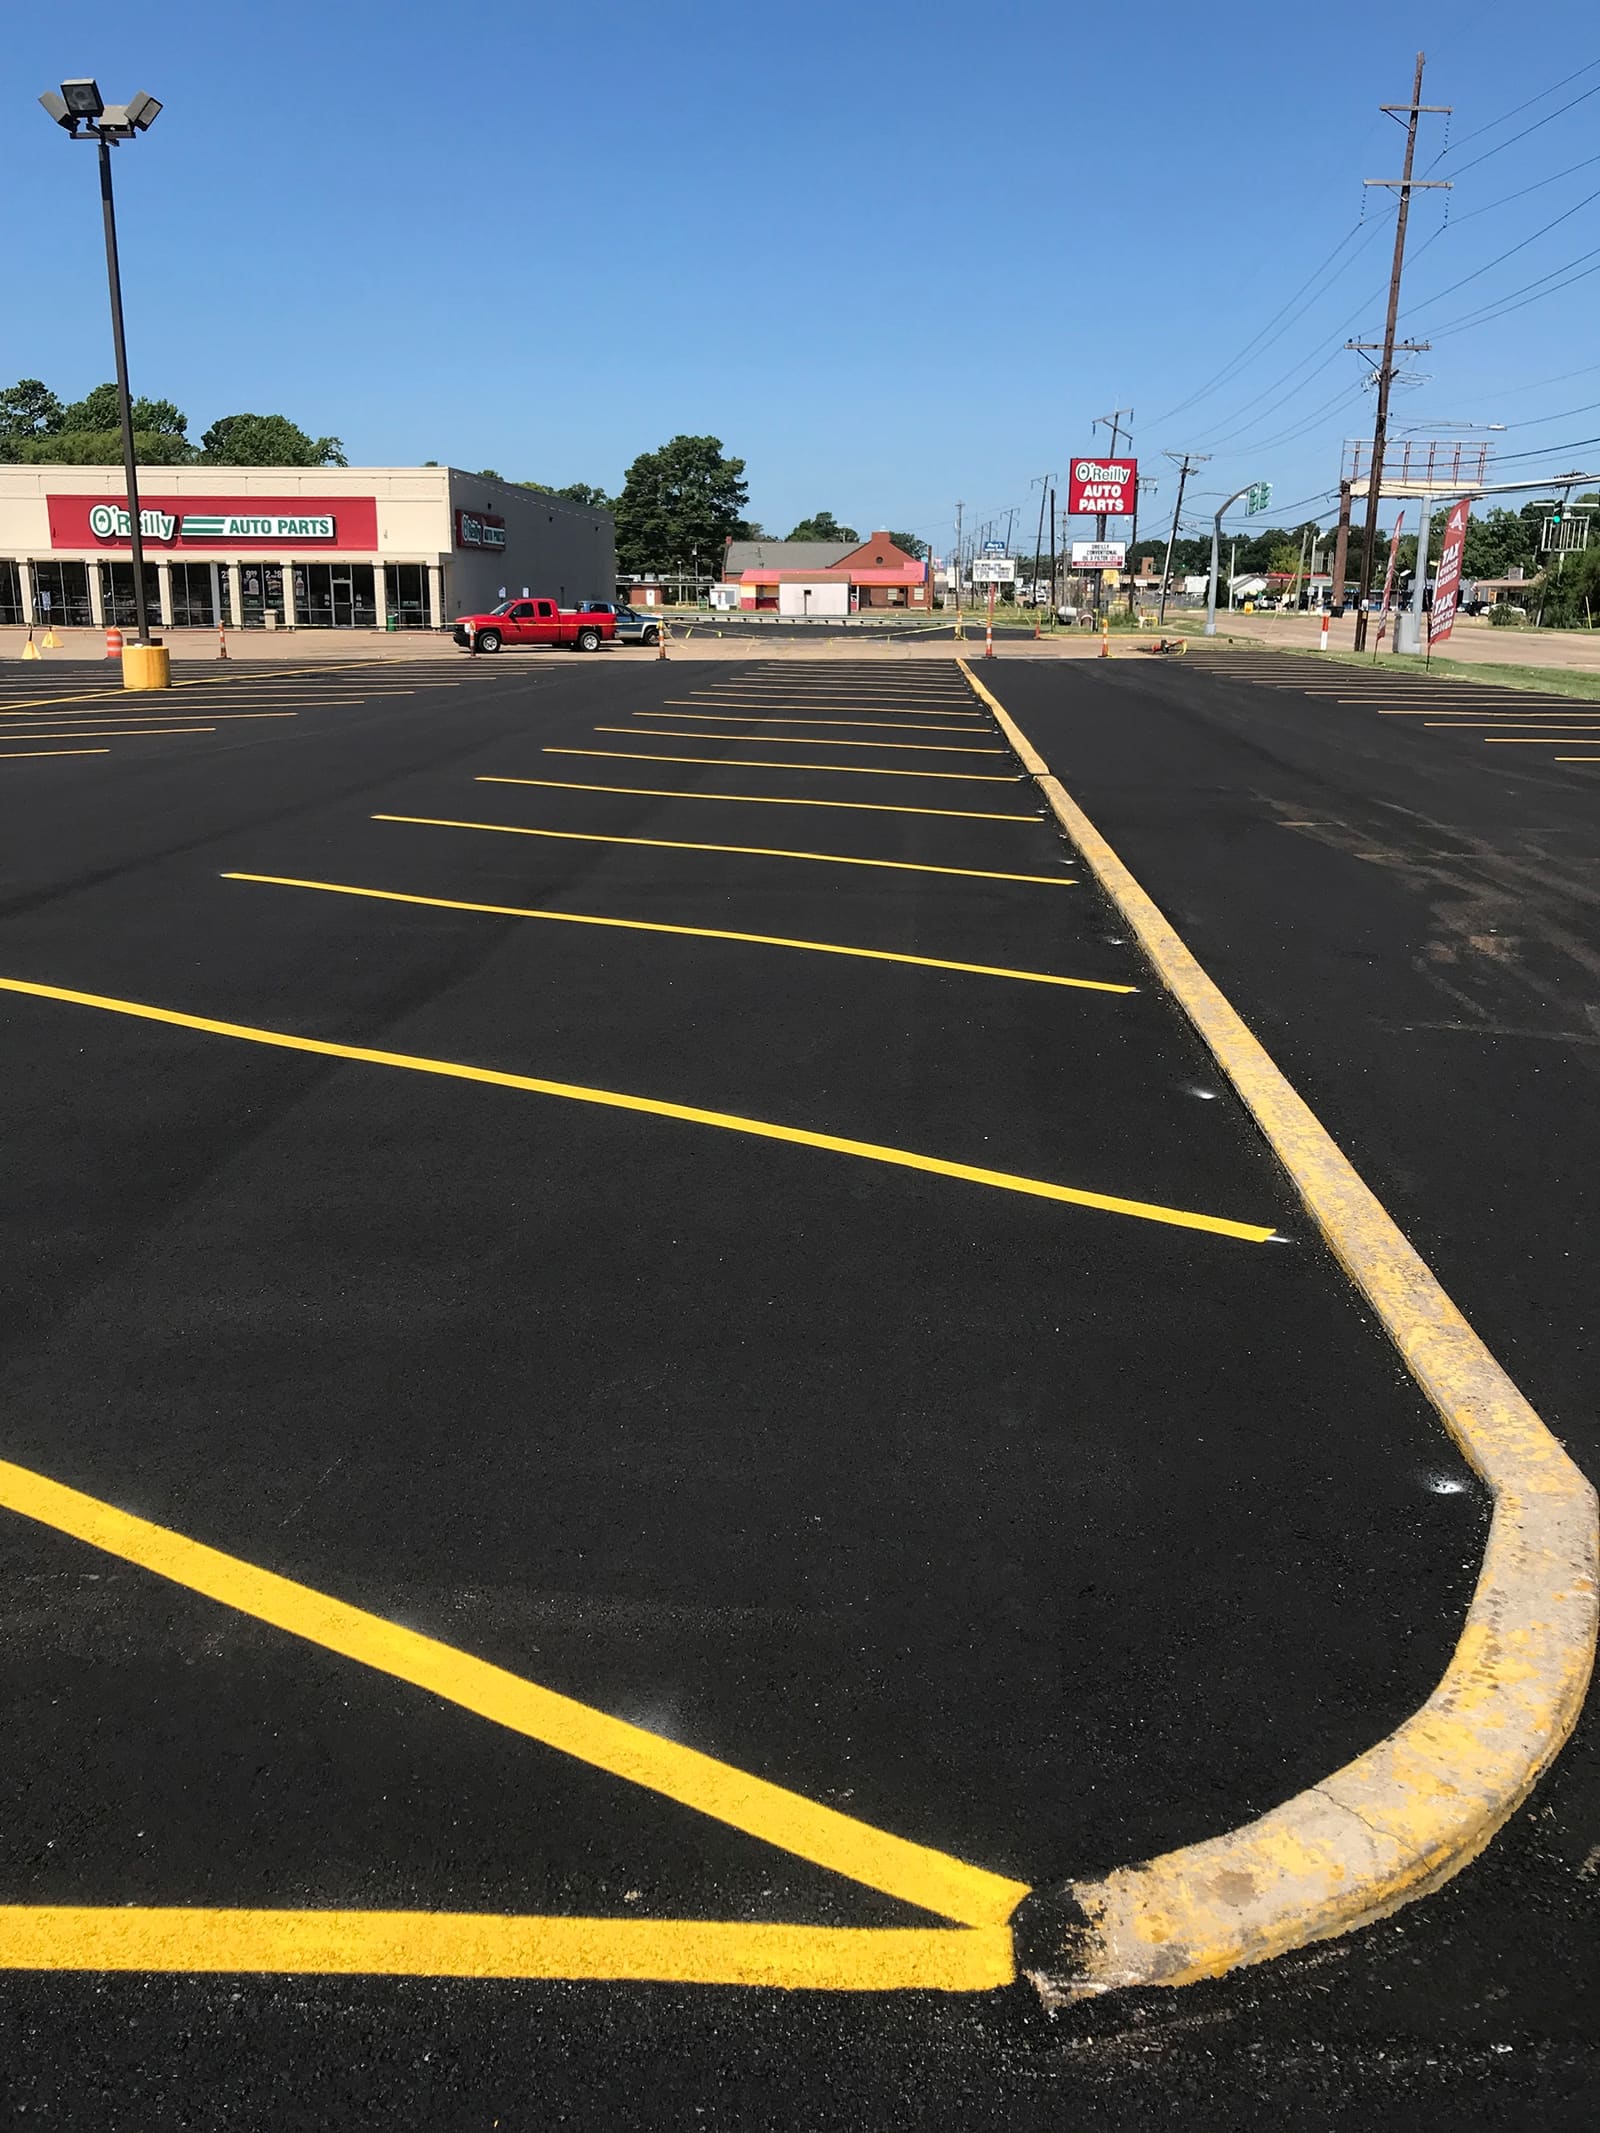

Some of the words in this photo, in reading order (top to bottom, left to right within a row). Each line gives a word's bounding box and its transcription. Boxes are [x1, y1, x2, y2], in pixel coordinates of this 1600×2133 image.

[1076, 463, 1130, 483] O'Reilly
[1083, 484, 1121, 498] AUTO
[1078, 498, 1124, 512] PARTS
[91, 506, 174, 539] O'Rilly
[229, 519, 272, 534] AUTO
[277, 519, 329, 535] PARTS
[1442, 540, 1461, 566] TAX
[1434, 590, 1456, 615] TAX
